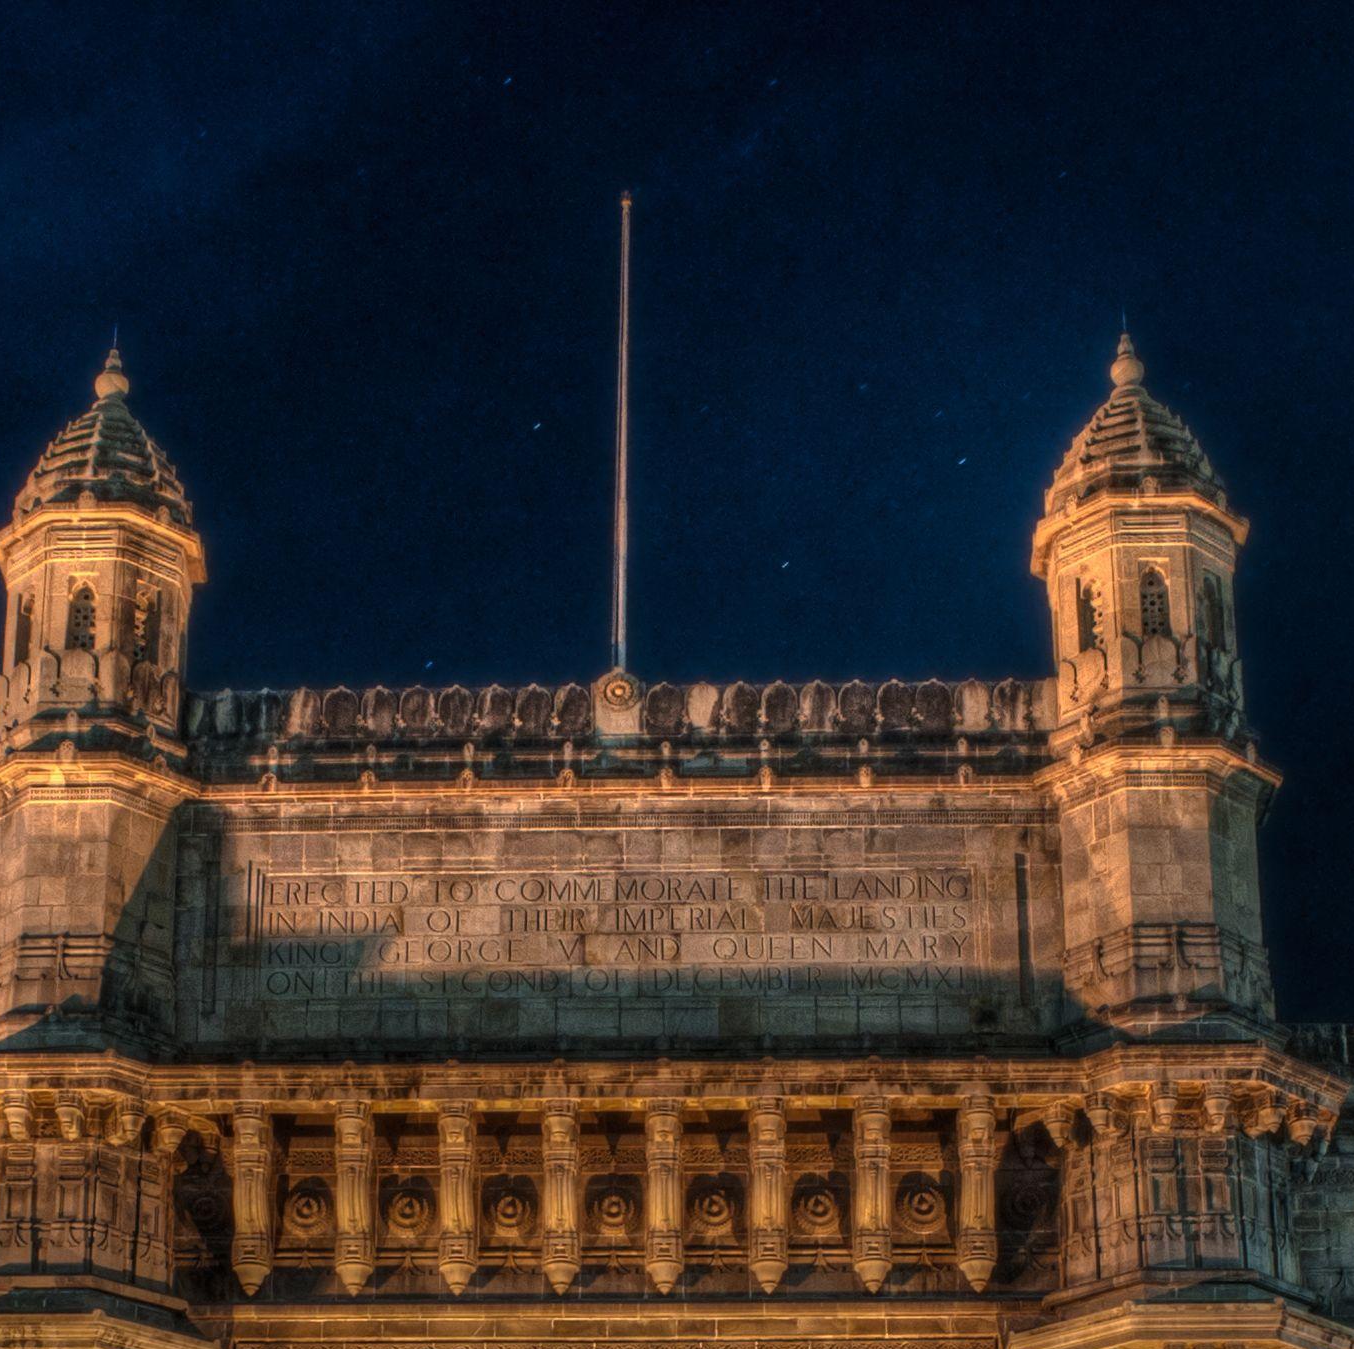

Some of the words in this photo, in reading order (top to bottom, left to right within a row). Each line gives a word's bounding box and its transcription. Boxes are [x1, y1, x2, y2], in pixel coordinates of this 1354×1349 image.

[269, 878, 408, 906] ERECTED
[433, 879, 474, 903] TO
[495, 876, 745, 903] COMMEMORATE
[762, 876, 818, 901] THE
[834, 874, 970, 900] LANDING
[268, 910, 296, 936] IN
[318, 910, 405, 935] INDIA
[426, 909, 473, 933] OF
[507, 908, 587, 933] THEIR
[615, 906, 751, 931] IMPERIAL
[791, 905, 968, 931] MAJESTIES
[267, 940, 343, 966] KING
[379, 938, 524, 965] GEORGE
[557, 936, 581, 962] V
[613, 935, 681, 962] AND
[712, 935, 834, 965] QUEEN
[864, 934, 970, 960] MARY
[266, 970, 316, 997] ON
[344, 971, 394, 994] THE
[420, 968, 560, 995] SECOND
[584, 967, 631, 993] OF
[653, 965, 823, 992] DECEMBER
[850, 964, 966, 990] MCMXI
